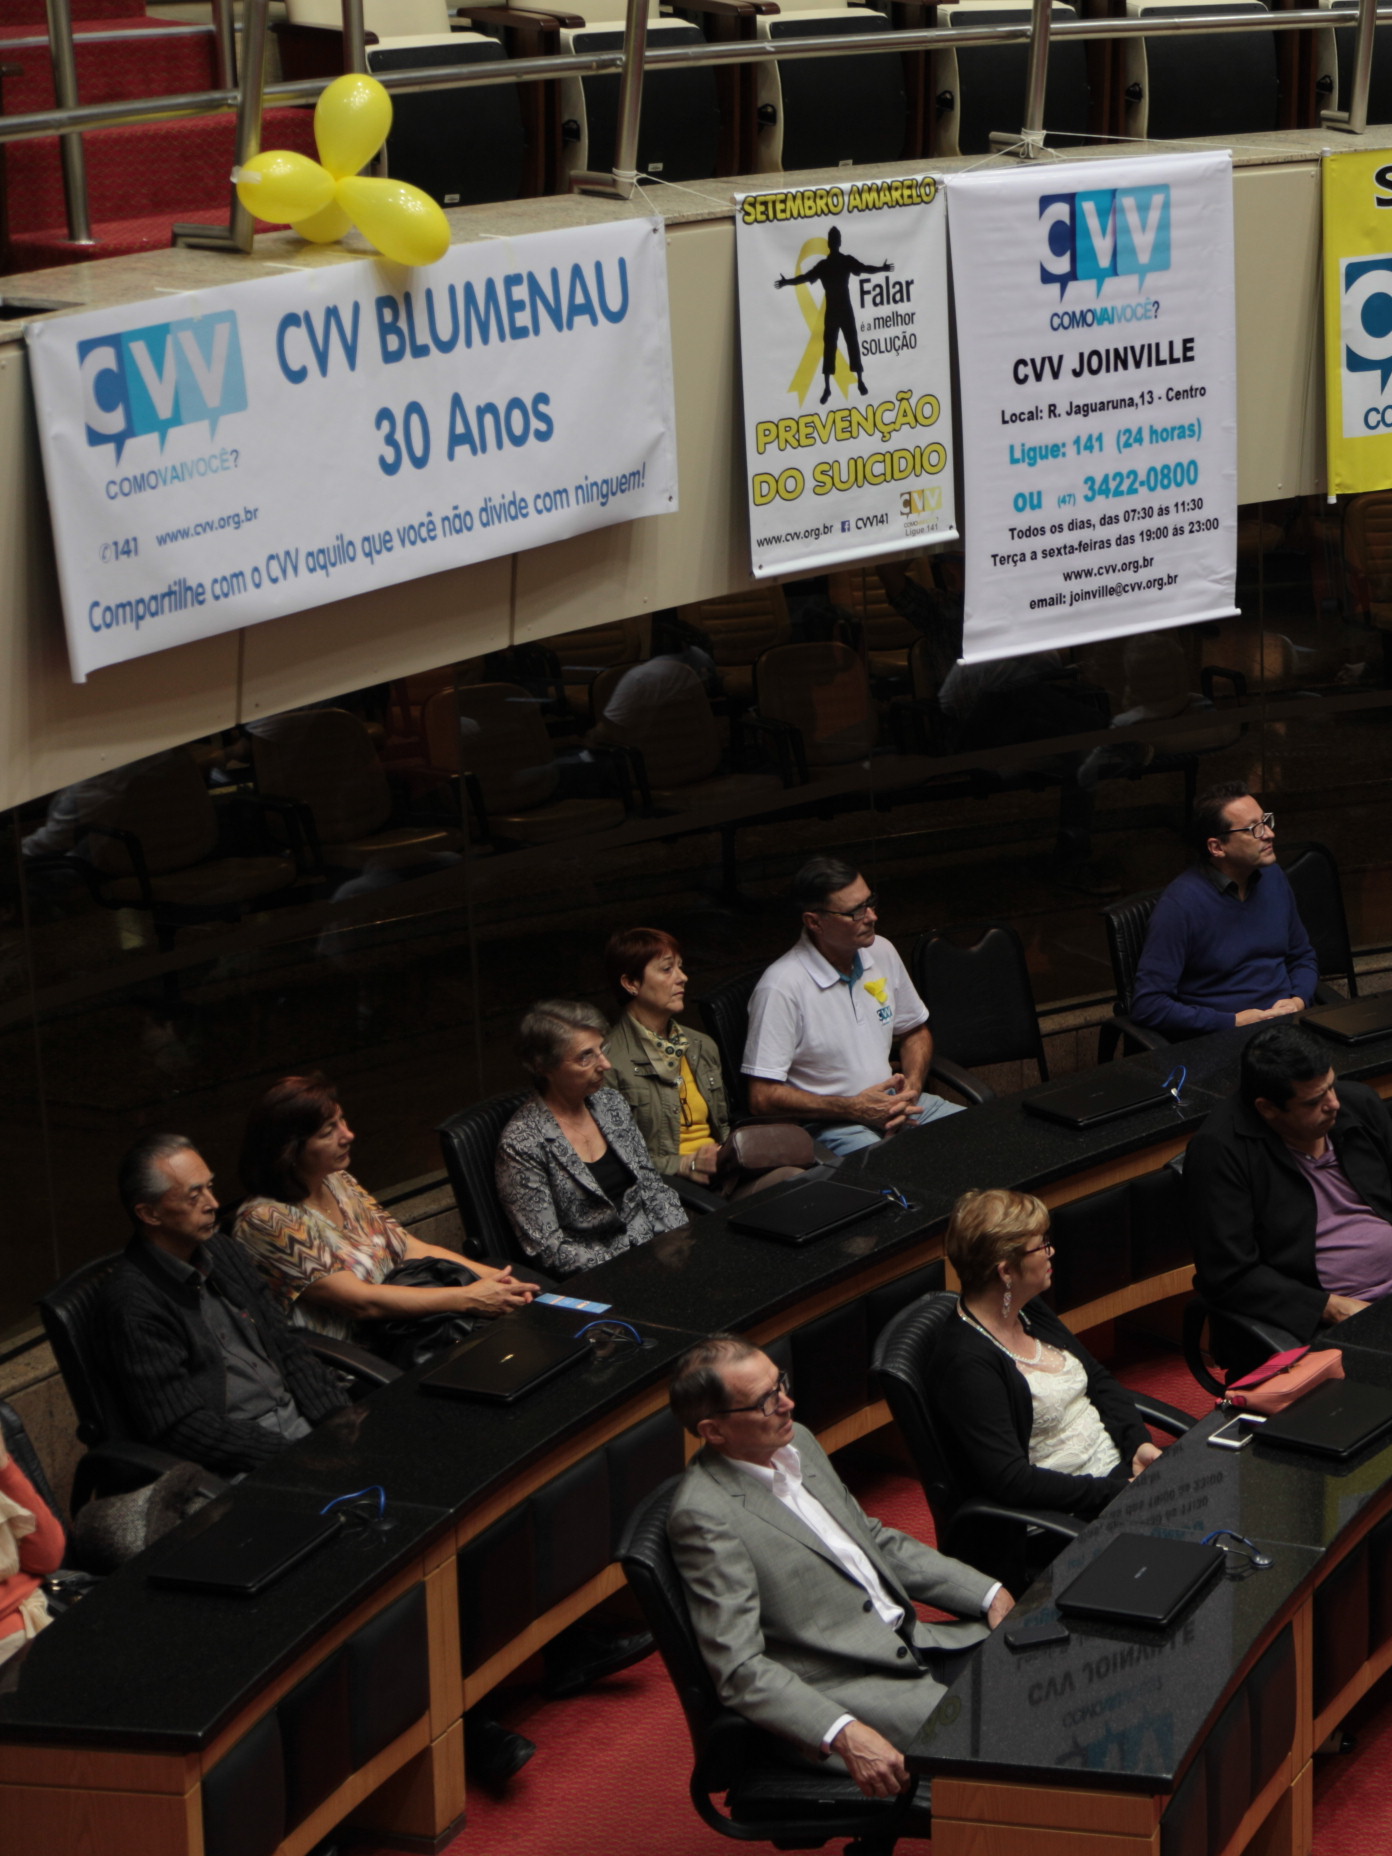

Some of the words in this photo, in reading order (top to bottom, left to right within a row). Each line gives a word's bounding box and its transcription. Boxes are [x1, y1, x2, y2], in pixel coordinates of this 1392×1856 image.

[742, 187, 844, 225] SETEMBRO
[848, 176, 936, 213] AMARELO
[1039, 193, 1166, 275] CVV
[859, 276, 914, 309] Falar
[276, 300, 360, 385] CVV
[375, 257, 629, 364] BLUMENAU
[860, 322, 865, 332] é
[867, 323, 872, 332] a
[873, 310, 916, 330] melhor
[1050, 297, 1160, 332] COMOVAIVOCÊ?
[861, 331, 917, 356] SOLUÇÃO
[1013, 354, 1064, 385] CVV
[1072, 337, 1195, 378] JOINVILLE
[80, 322, 231, 435] CVV
[756, 389, 940, 454] PREVENÇÃO
[1001, 406, 1043, 425] Local:
[1048, 403, 1061, 419] R.
[1166, 385, 1206, 402] Centro
[375, 401, 430, 476] 30
[447, 392, 554, 462] Anos
[1009, 442, 1067, 467] Ligue:
[1072, 432, 1104, 455] 141
[1116, 426, 1144, 454] (24
[1149, 417, 1202, 444] horas)
[752, 468, 805, 506] DO
[813, 442, 947, 495] SUICIDIO
[1013, 490, 1042, 512] ou
[1057, 493, 1076, 509] (47)
[1083, 459, 1199, 502] 3422-0800
[900, 488, 940, 515] CVV
[1009, 525, 1046, 541] Todos
[1050, 525, 1064, 535] os
[1067, 518, 1096, 532] dias,
[1099, 513, 1120, 527] das
[1123, 506, 1154, 523] 07:30
[1174, 498, 1204, 514] 11:30
[89, 576, 206, 632] Compartilhe
[211, 569, 247, 602] com
[251, 565, 262, 589] o
[266, 548, 300, 584] CVV
[305, 533, 356, 578] aquilo
[361, 530, 393, 565] que
[397, 511, 437, 549] você
[441, 505, 474, 538] não
[479, 491, 529, 528] divide
[534, 486, 570, 516] com
[575, 461, 646, 507] ninguem!
[156, 506, 259, 546] www.cvv.org.br
[757, 524, 834, 547] www.cvv.org.br
[855, 513, 889, 530] CVV141
[905, 526, 925, 537] Ligue
[927, 522, 938, 533] 141
[991, 549, 1026, 567] Terça
[1030, 550, 1038, 561] a
[1041, 539, 1112, 559] sexta-feiras
[1115, 533, 1136, 547] das
[1139, 526, 1169, 543] 19:00
[1188, 518, 1219, 534] 23:00
[112, 536, 139, 561] 141
[1062, 555, 1154, 582] www.cvv.org.br
[1029, 593, 1067, 610] email:
[1069, 573, 1178, 607] joinville@cvv.org.br
